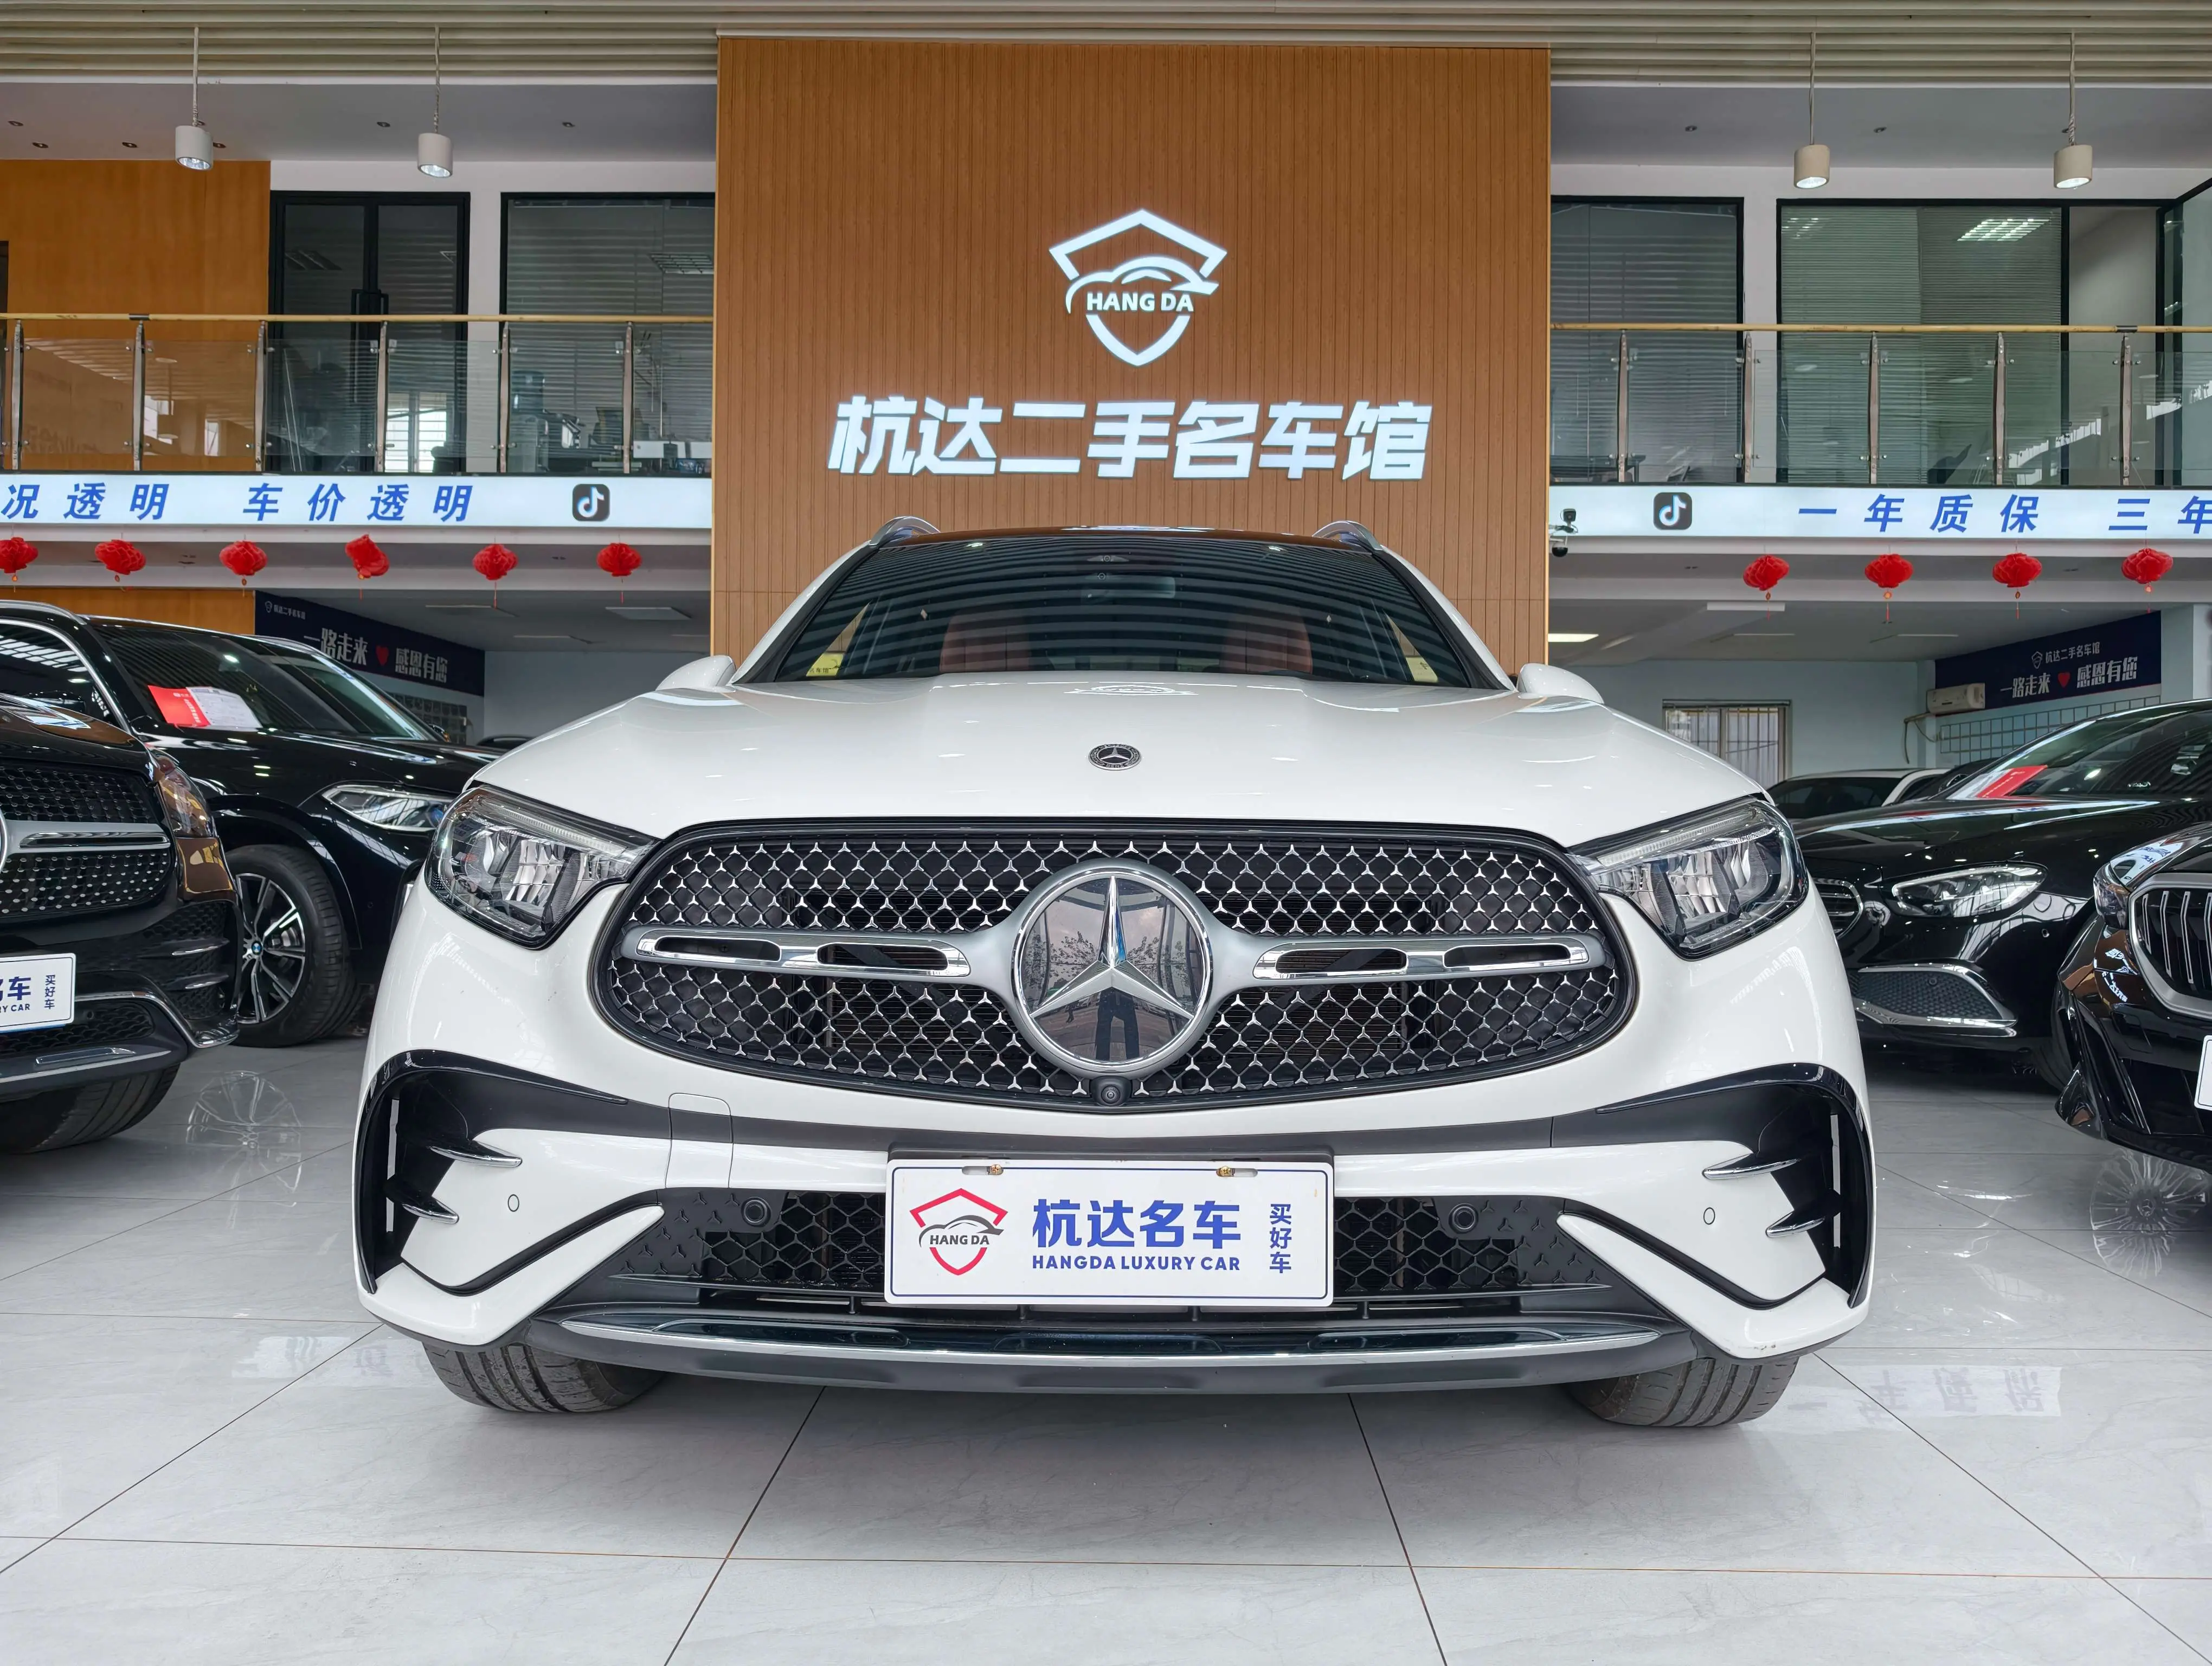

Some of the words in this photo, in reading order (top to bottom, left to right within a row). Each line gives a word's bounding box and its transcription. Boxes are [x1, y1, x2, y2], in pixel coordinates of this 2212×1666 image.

[1086, 291, 1155, 312] HANG
[1160, 292, 1194, 312] DA
[827, 396, 1432, 480] 杭达二手名车馆
[1, 482, 169, 520] 况透明
[242, 483, 473, 522] 车价透明
[1798, 494, 2039, 533] 一年质保
[2108, 495, 2212, 534] 三年
[304, 627, 368, 666] 一路走来
[395, 648, 448, 683] 感恩有您
[2000, 672, 2050, 699] 一路走来
[2076, 656, 2138, 688] 感恩有您
[0, 976, 31, 1001] 车
[11, 1003, 30, 1011] CAR
[44, 975, 55, 1009] 买好车
[930, 1235, 968, 1245] HANG
[971, 1235, 989, 1245] DA
[1032, 1199, 1240, 1249] 杭达名车
[1270, 1203, 1292, 1274] 买好车
[1032, 1255, 1115, 1270] HANGDA
[1121, 1257, 1195, 1270] LUXURY
[1200, 1257, 1240, 1270] CAR
